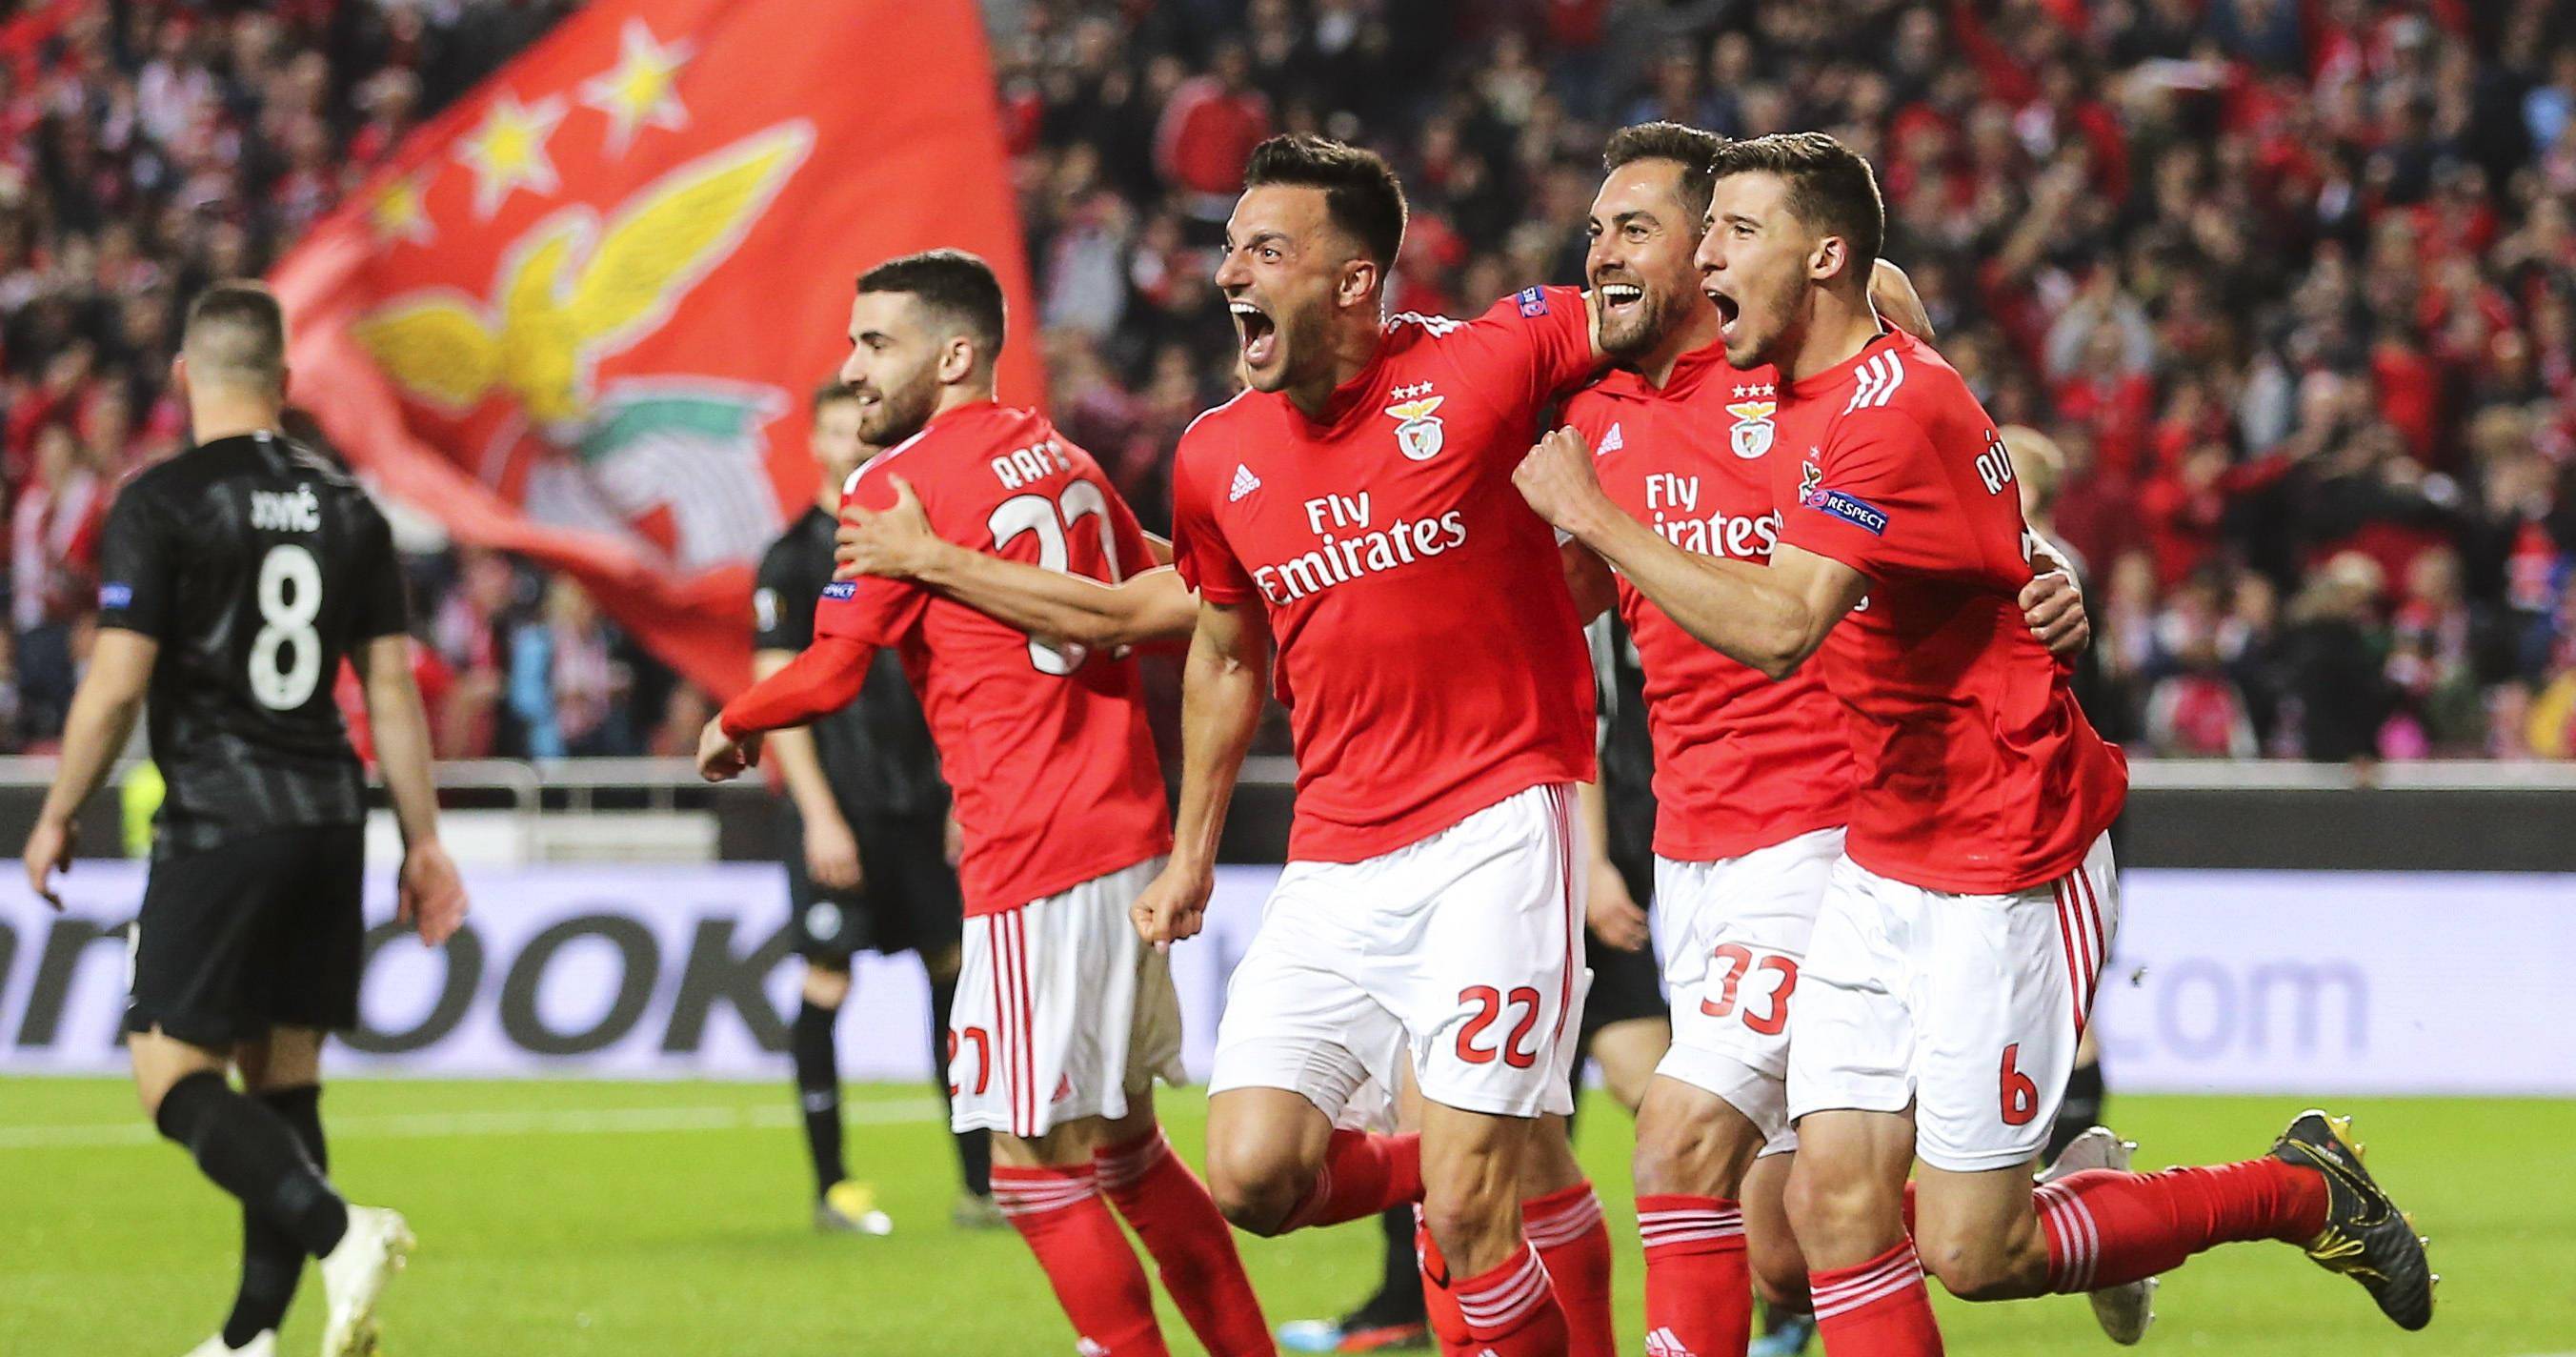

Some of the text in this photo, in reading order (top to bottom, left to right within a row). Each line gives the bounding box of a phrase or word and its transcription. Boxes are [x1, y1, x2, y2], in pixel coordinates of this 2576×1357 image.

[1303, 490, 1372, 536] Fly
[1645, 472, 1700, 513] Fly
[1652, 509, 1779, 557] irates
[1827, 496, 1886, 530] RESPECT
[1253, 509, 1468, 606] Emirates
[248, 542, 324, 712] 8
[1456, 984, 1540, 1068] 22
[1701, 942, 1800, 1036] 33
[2001, 1042, 2039, 1125] 6
